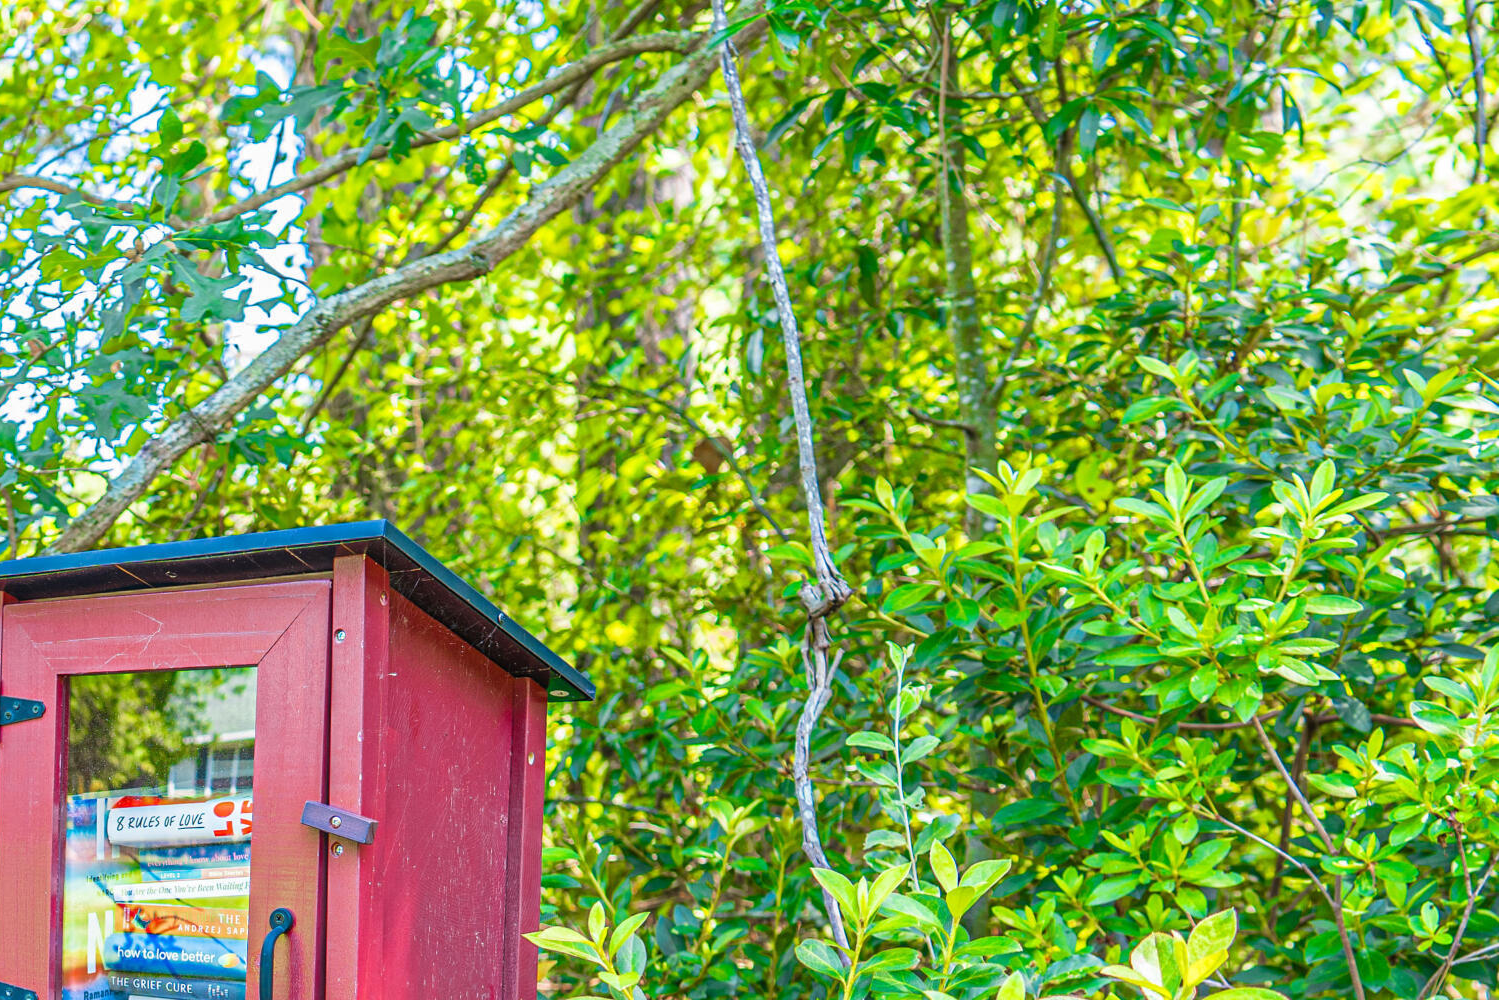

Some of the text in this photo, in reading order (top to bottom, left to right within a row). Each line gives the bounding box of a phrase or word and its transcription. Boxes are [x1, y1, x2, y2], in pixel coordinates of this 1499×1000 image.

[116, 812, 206, 832] 8 RULES OF LOVE
[147, 857, 182, 868] everything
[189, 855, 208, 864] know
[211, 853, 231, 862] about
[233, 852, 249, 860] love
[197, 884, 214, 892] Been
[216, 881, 243, 891] Waiting
[219, 913, 241, 925] THE
[178, 924, 221, 935] ANDRZEJ
[117, 946, 215, 963] how to love better
[111, 976, 129, 987] THE
[133, 978, 162, 991] GRIEF
[166, 982, 193, 994] CURE
